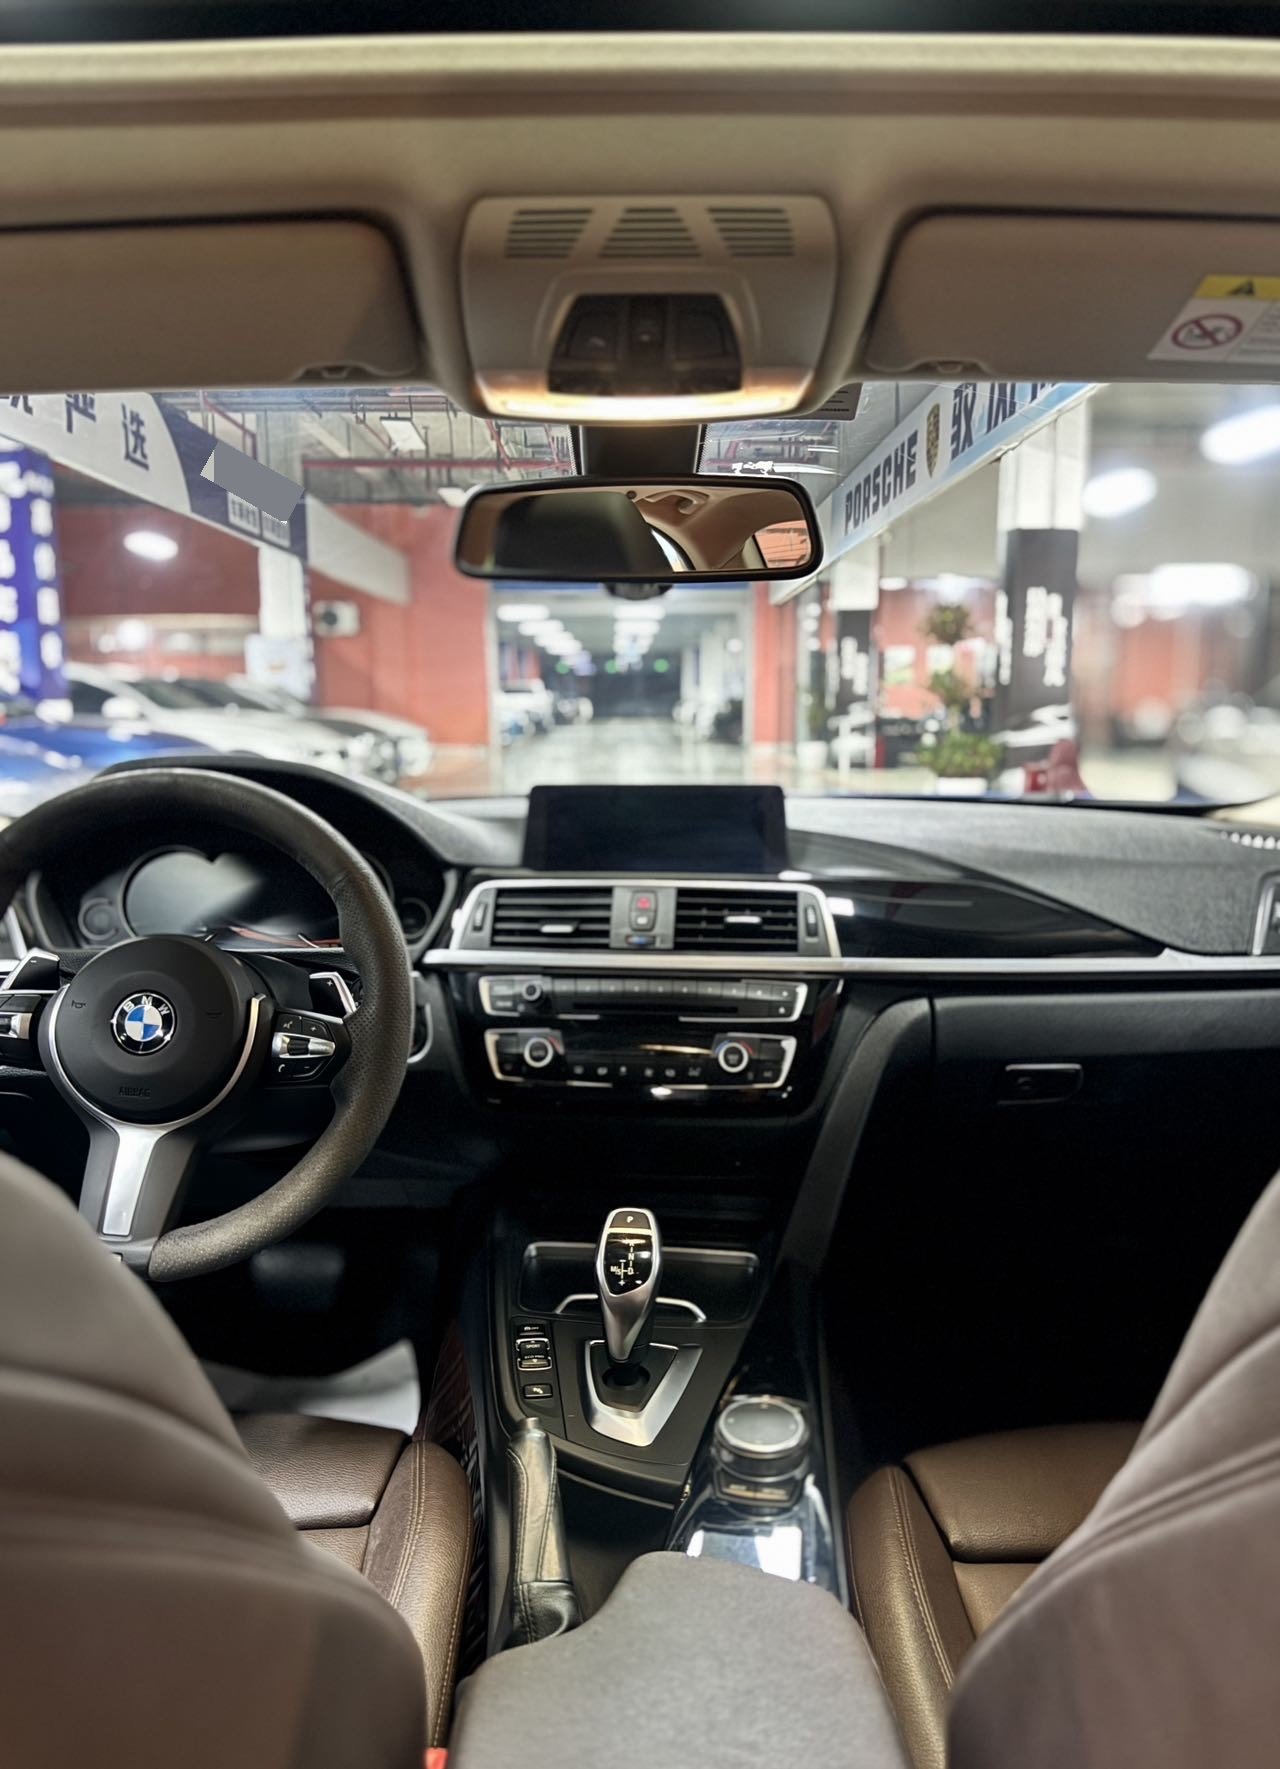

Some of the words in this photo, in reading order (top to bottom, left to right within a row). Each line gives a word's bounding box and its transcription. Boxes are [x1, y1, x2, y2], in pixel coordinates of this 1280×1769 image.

[844, 429, 918, 536] PORSCHE
[123, 996, 170, 1016] BMW
[626, 1215, 634, 1224] P
[627, 1253, 635, 1261] N
[627, 1267, 635, 1275] D
